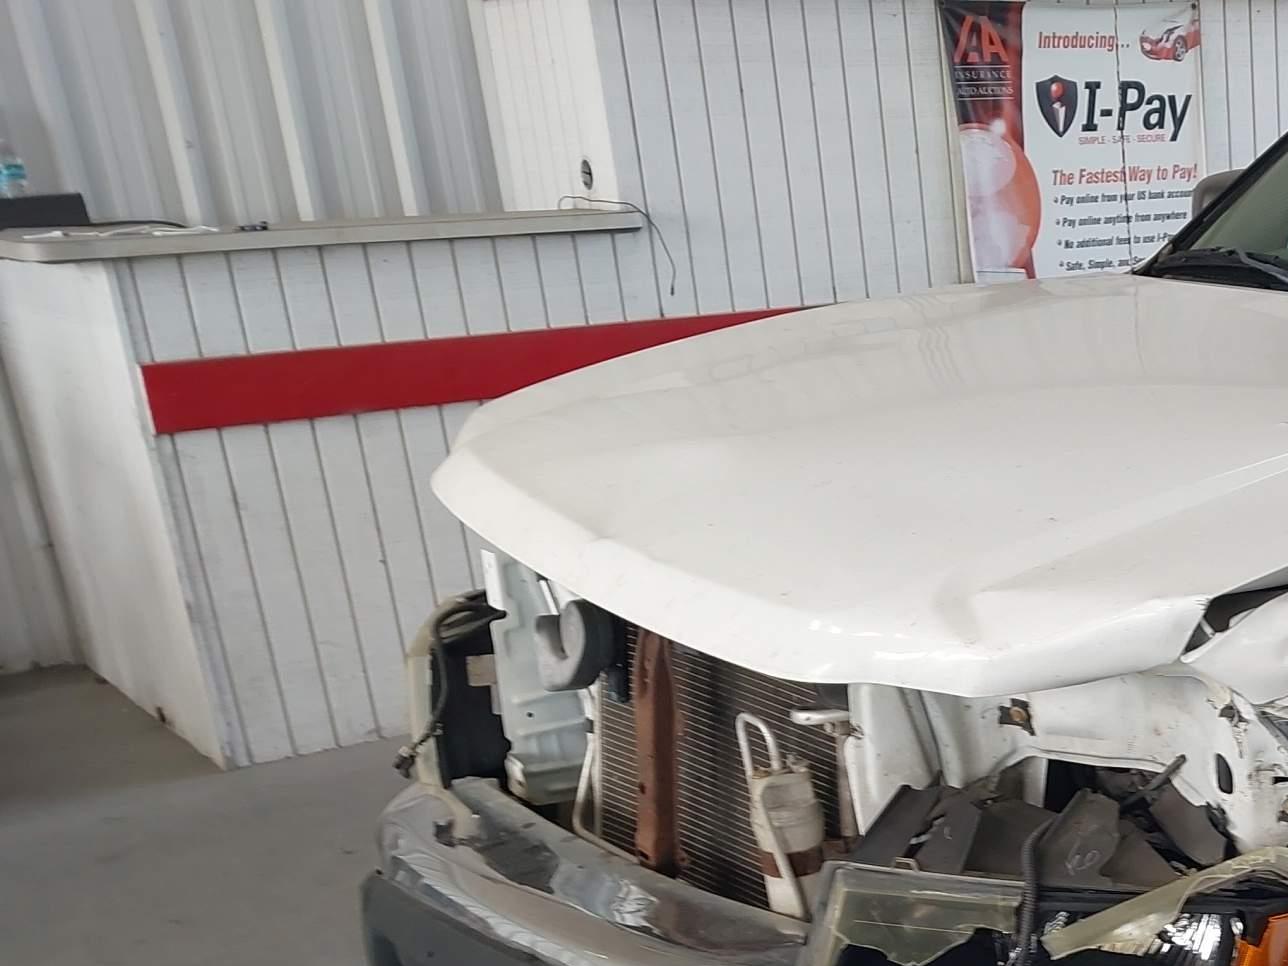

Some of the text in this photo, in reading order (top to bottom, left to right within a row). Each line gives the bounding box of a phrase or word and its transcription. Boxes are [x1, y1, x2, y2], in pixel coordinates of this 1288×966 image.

[1081, 80, 1193, 142] I-Pay
[1078, 136, 1106, 145] SIMPLE
[1112, 135, 1131, 144] SAFE
[1137, 134, 1166, 143] SECURE
[1052, 163, 1198, 186] The Fastest Way to Pay!
[1060, 195, 1075, 206] Pay
[1076, 193, 1099, 204] online
[1101, 192, 1117, 203] from
[1137, 190, 1146, 201] US
[1148, 189, 1164, 200] bank
[1167, 189, 1192, 199] accoun
[1062, 217, 1076, 229] Pay
[1078, 215, 1102, 226] online
[1135, 212, 1151, 223] from
[1153, 211, 1187, 223] anywhere
[1064, 239, 1074, 249] No
[1076, 236, 1114, 249] additional
[1133, 234, 1141, 244] to
[1143, 234, 1155, 244] use
